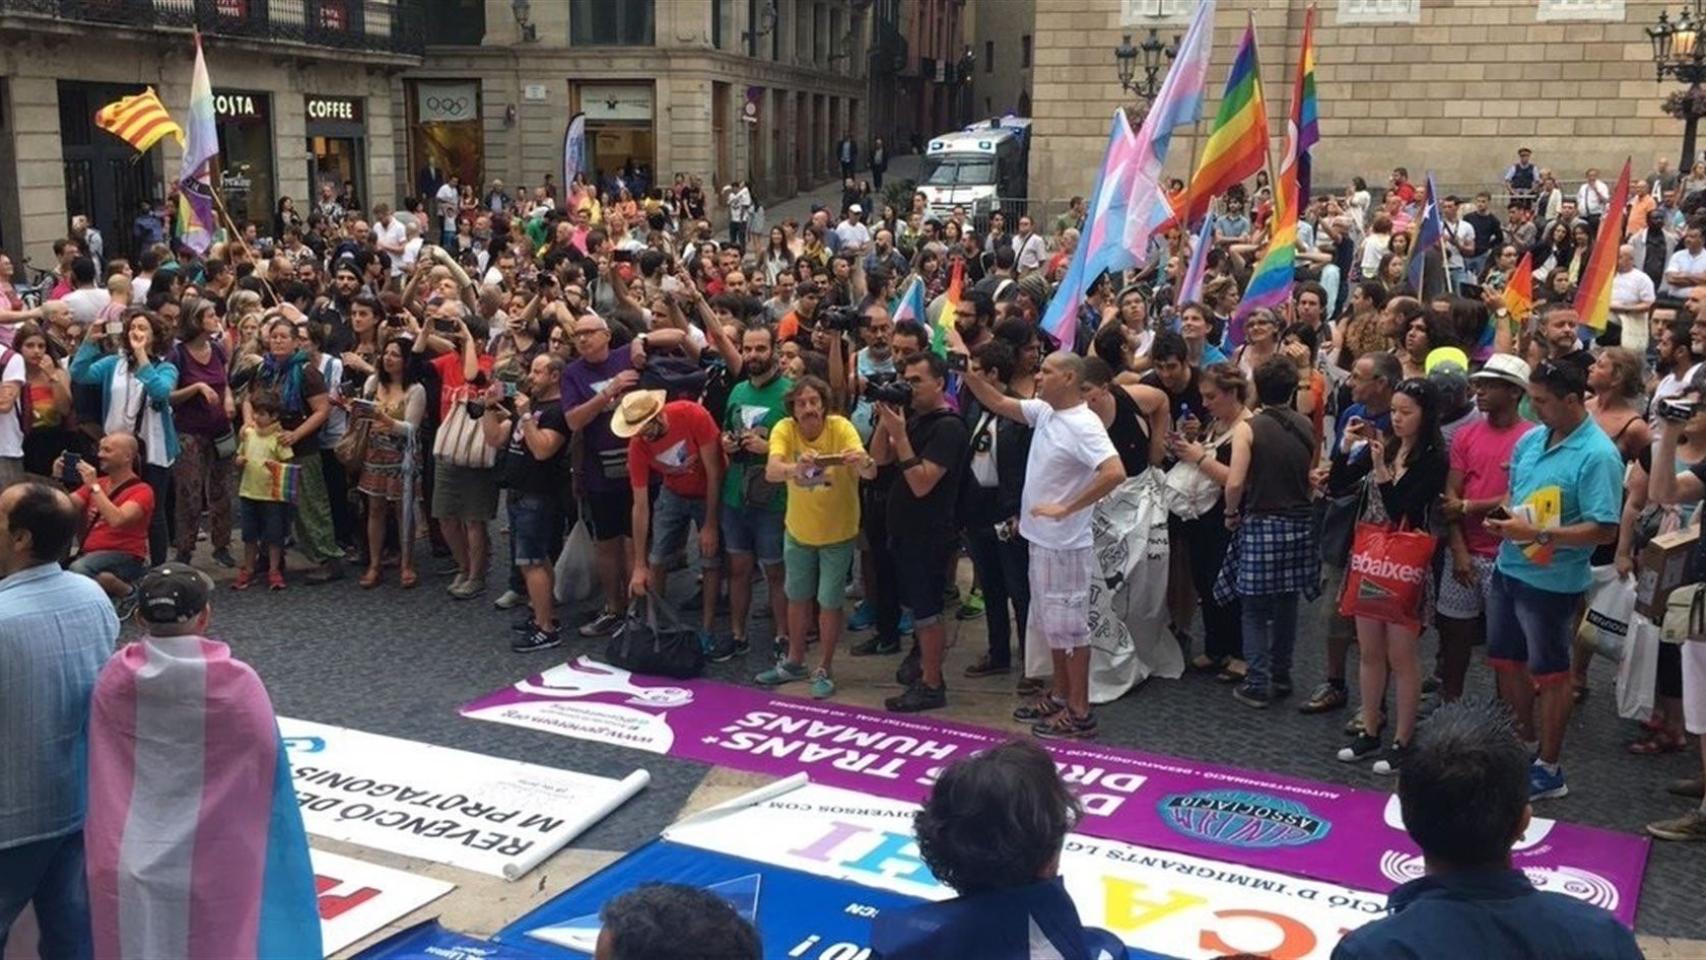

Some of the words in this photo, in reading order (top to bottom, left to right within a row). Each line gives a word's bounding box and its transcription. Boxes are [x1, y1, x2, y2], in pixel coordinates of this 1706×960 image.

[213, 95, 254, 117] OSTA
[308, 101, 353, 119] COFFEE
[734, 711, 958, 761] HUMANS
[289, 763, 521, 824] PROTAGONIS
